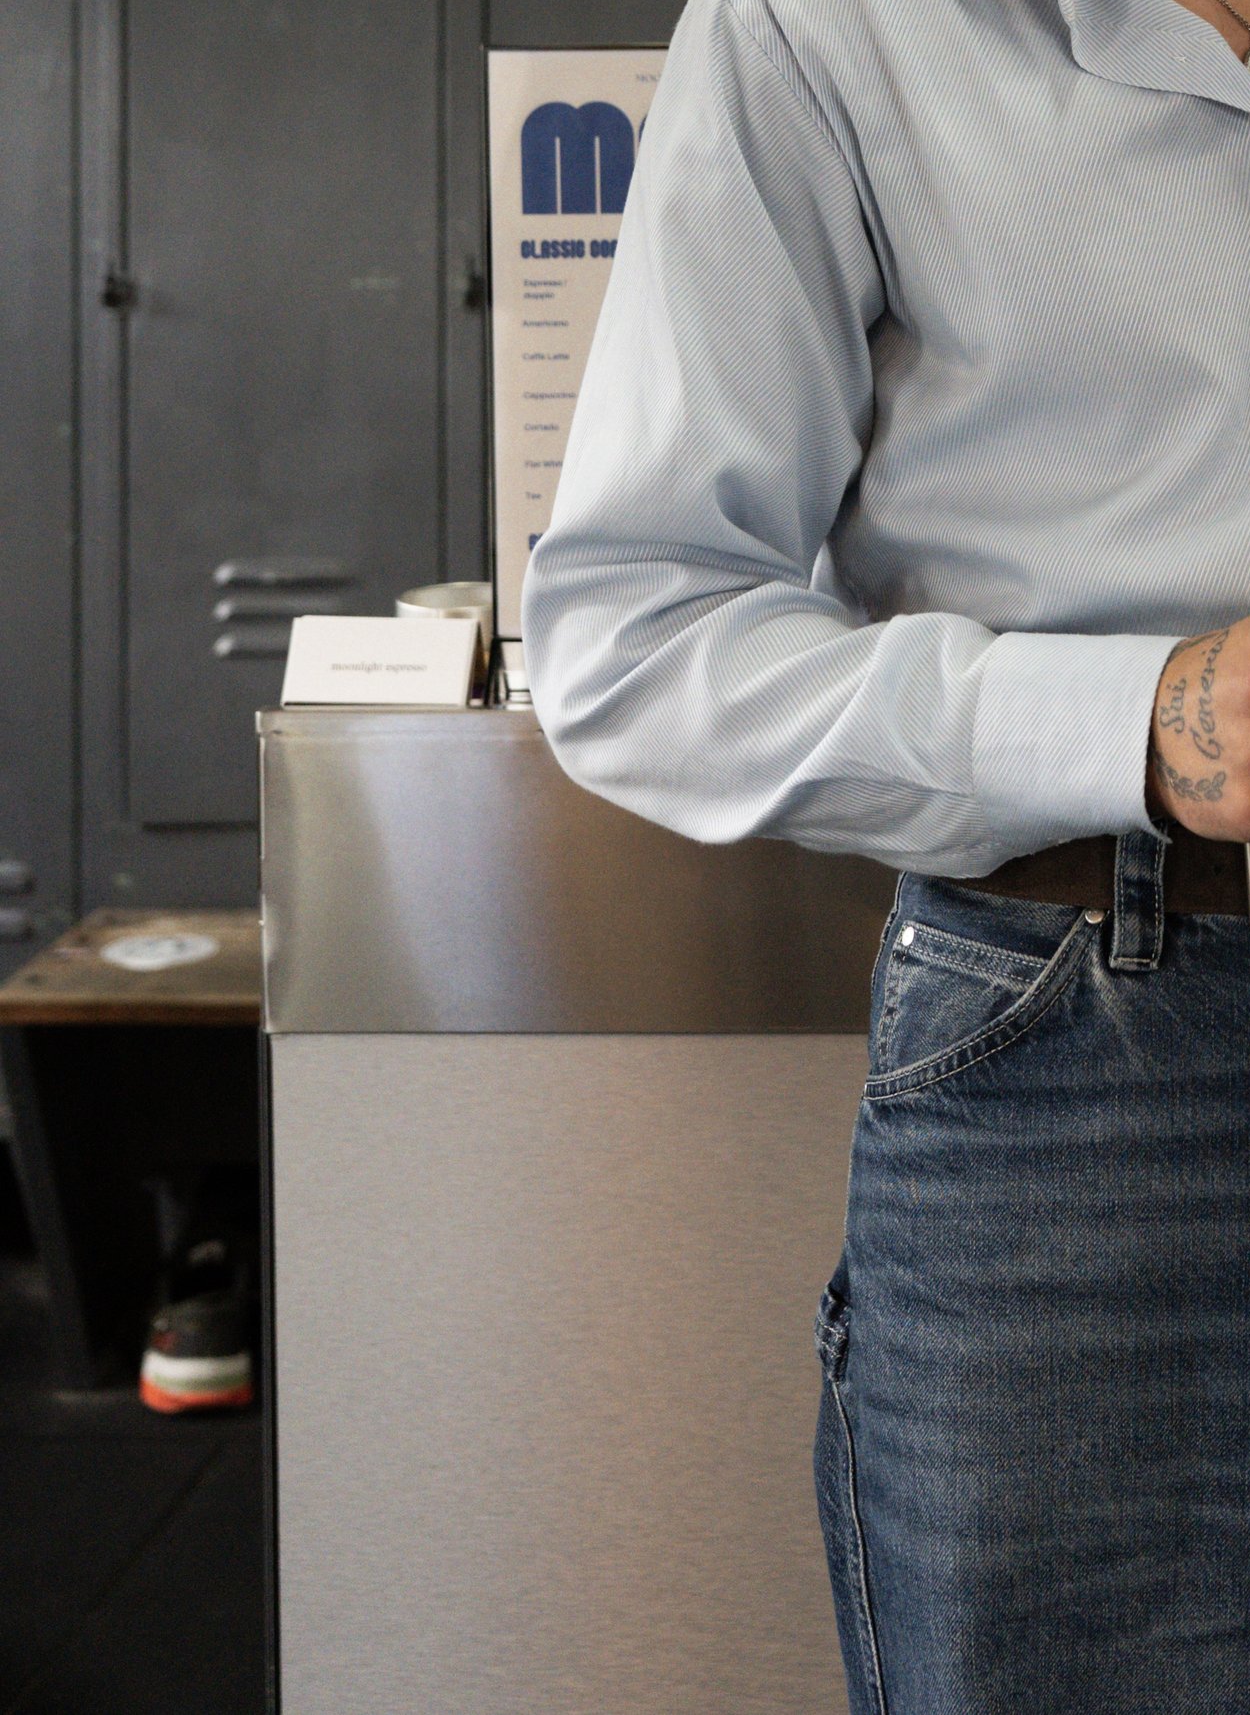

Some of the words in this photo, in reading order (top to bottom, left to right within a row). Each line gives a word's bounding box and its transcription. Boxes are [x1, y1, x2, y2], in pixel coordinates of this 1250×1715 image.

[521, 239, 585, 259] CLASSIC
[523, 318, 569, 327] Americano
[523, 391, 577, 401] Cappuccino
[524, 421, 560, 431] Cortado
[543, 459, 563, 468] Whit
